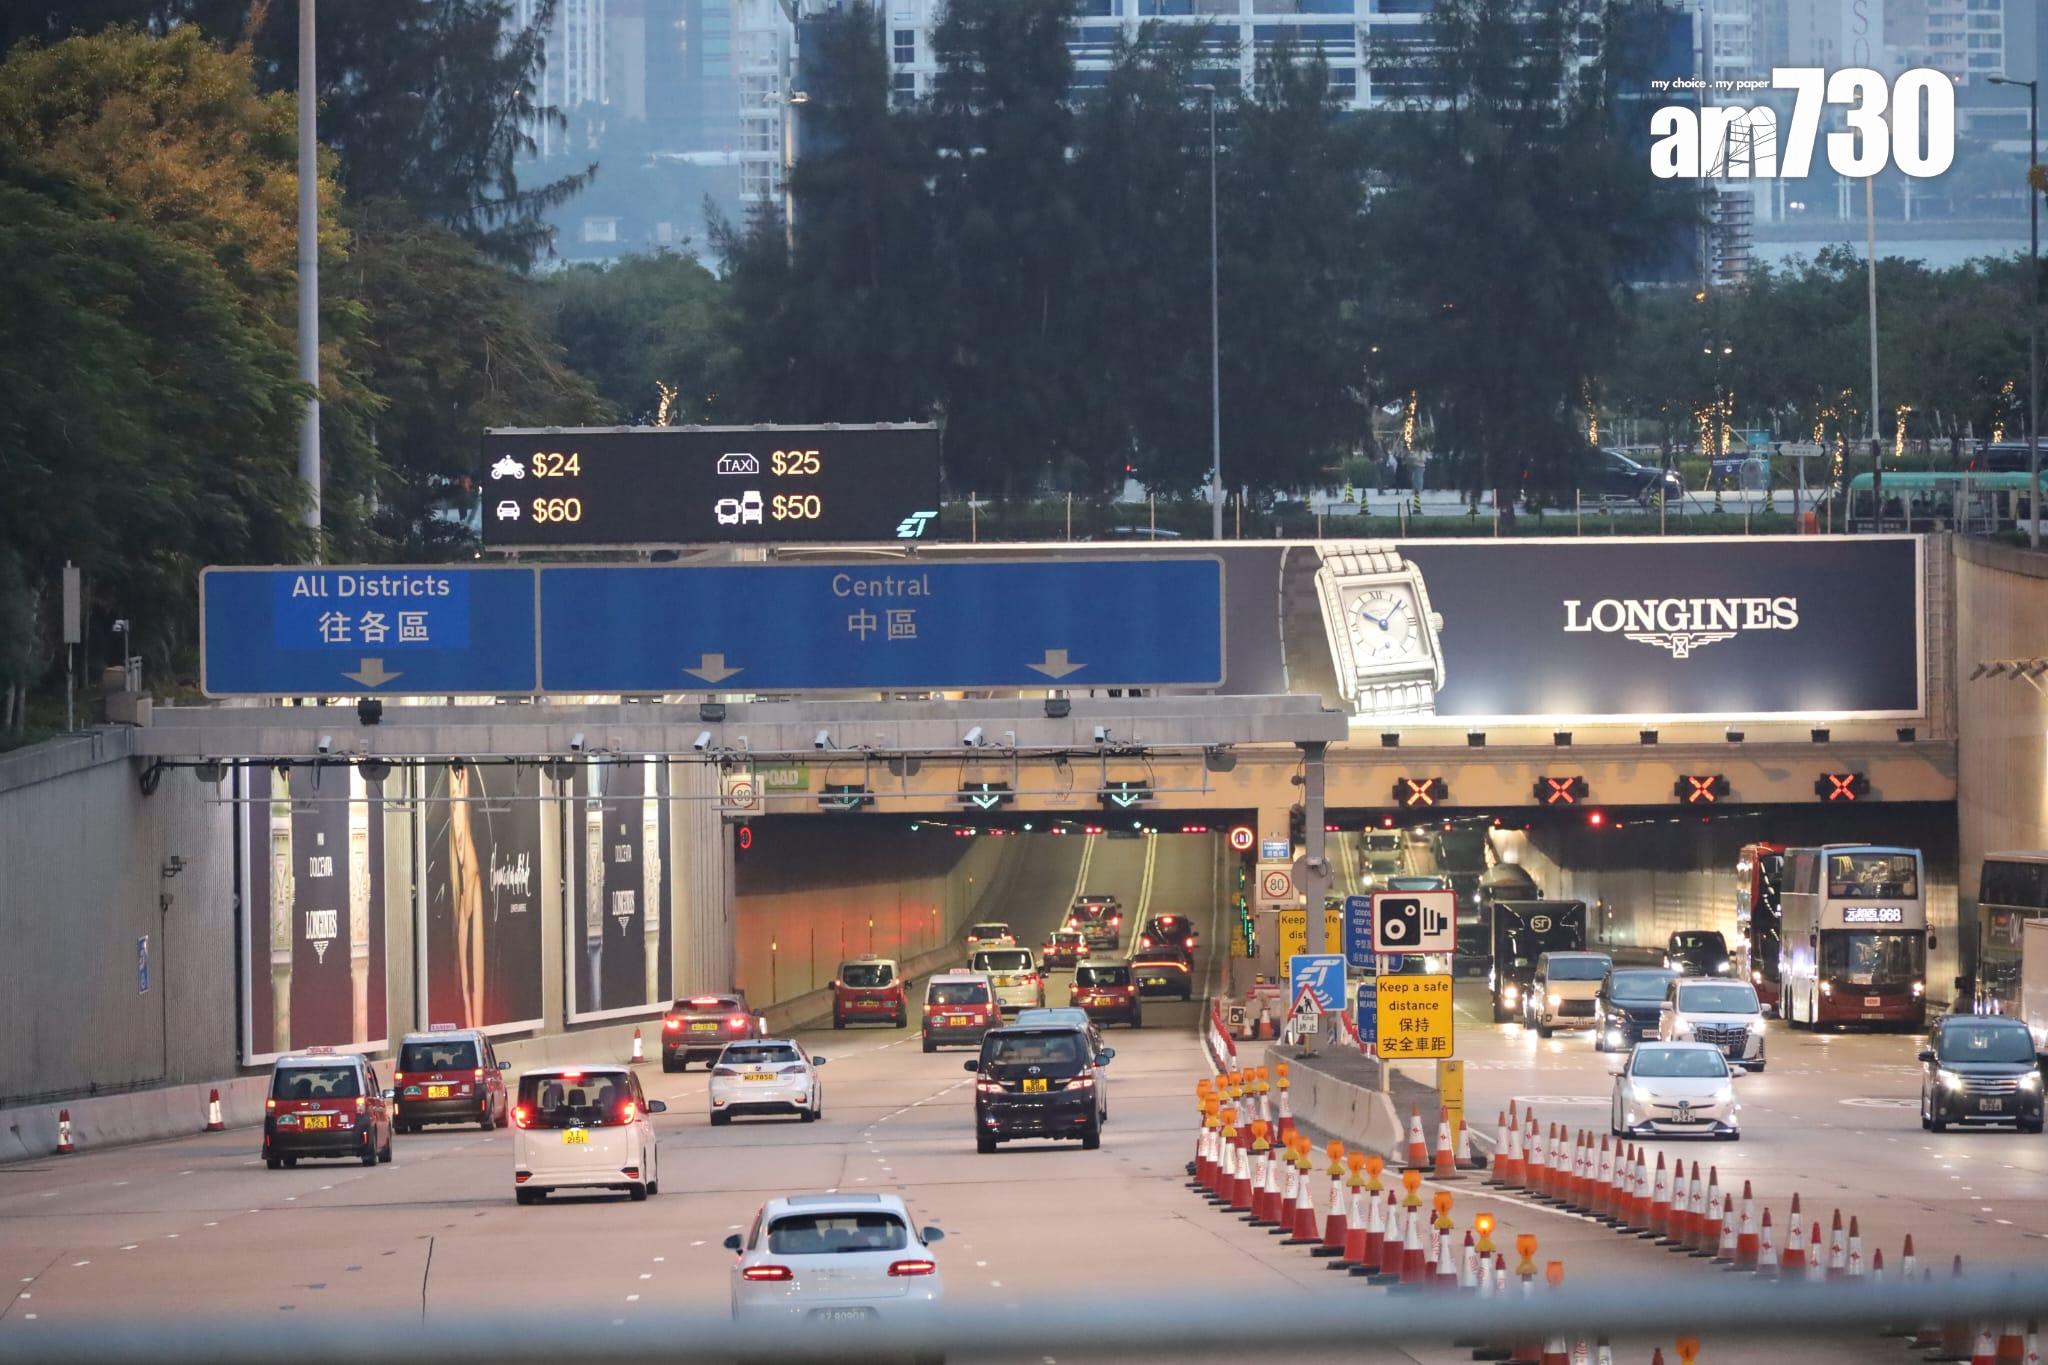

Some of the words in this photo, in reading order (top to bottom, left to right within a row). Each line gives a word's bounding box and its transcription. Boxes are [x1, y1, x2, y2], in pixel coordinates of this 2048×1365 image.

[532, 452, 580, 478] $24
[724, 459, 753, 472] TAXI
[771, 450, 821, 476] $25
[532, 498, 581, 523] $60
[771, 495, 821, 520] $50
[292, 575, 328, 597] All
[338, 575, 450, 597] Districts
[832, 573, 931, 597] Central
[847, 607, 917, 641] 中區
[1563, 597, 1799, 632] LONGINES
[318, 611, 430, 643] 往各區
[764, 769, 799, 785] OAD
[1270, 878, 1284, 891] 80
[1281, 915, 1306, 926] Keep
[1879, 908, 1901, 922] 968
[1379, 982, 1409, 994] Keep
[1413, 983, 1420, 992] a
[1424, 981, 1449, 992] safe
[1389, 1000, 1439, 1011] distance
[1399, 1017, 1430, 1032] 保持
[1383, 1036, 1447, 1052] 安全車距
